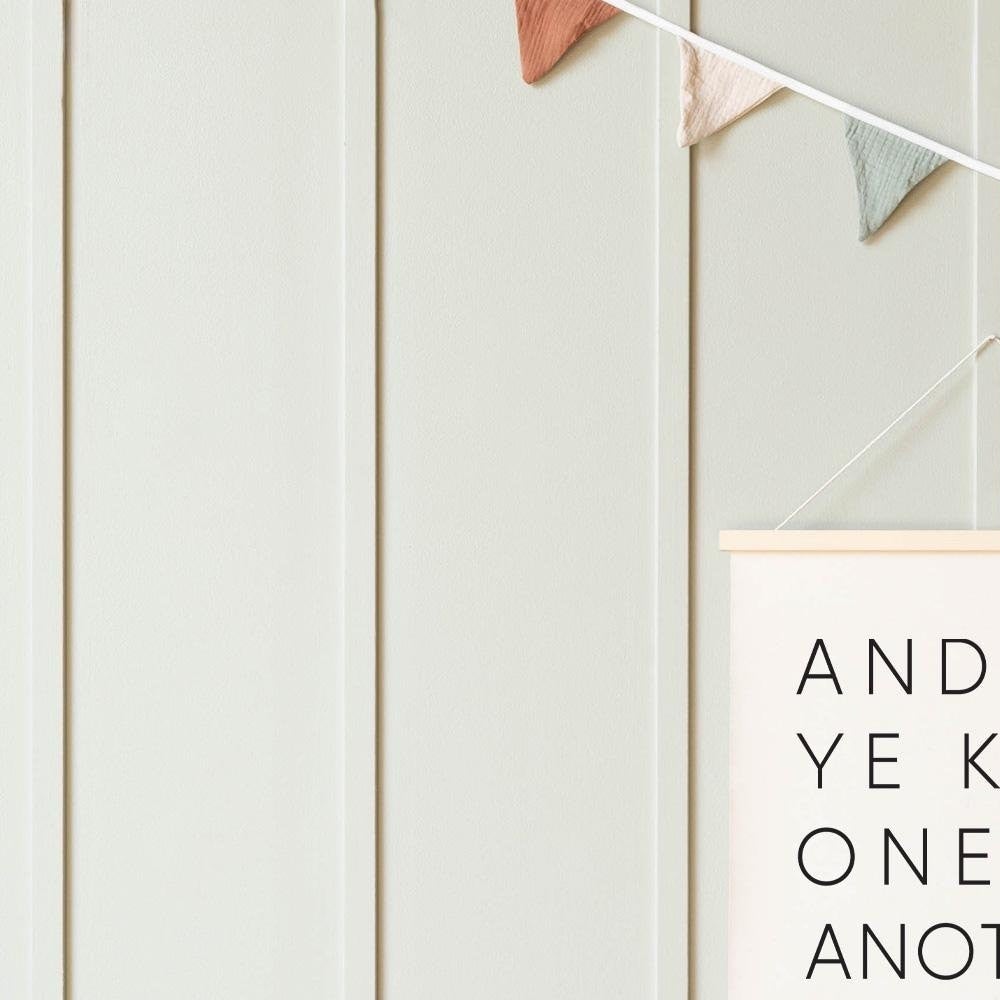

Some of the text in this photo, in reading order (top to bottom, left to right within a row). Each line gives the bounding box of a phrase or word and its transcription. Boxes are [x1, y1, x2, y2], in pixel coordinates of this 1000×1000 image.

[797, 638, 987, 695] AND
[796, 732, 901, 789] YE
[797, 826, 991, 887] ONE
